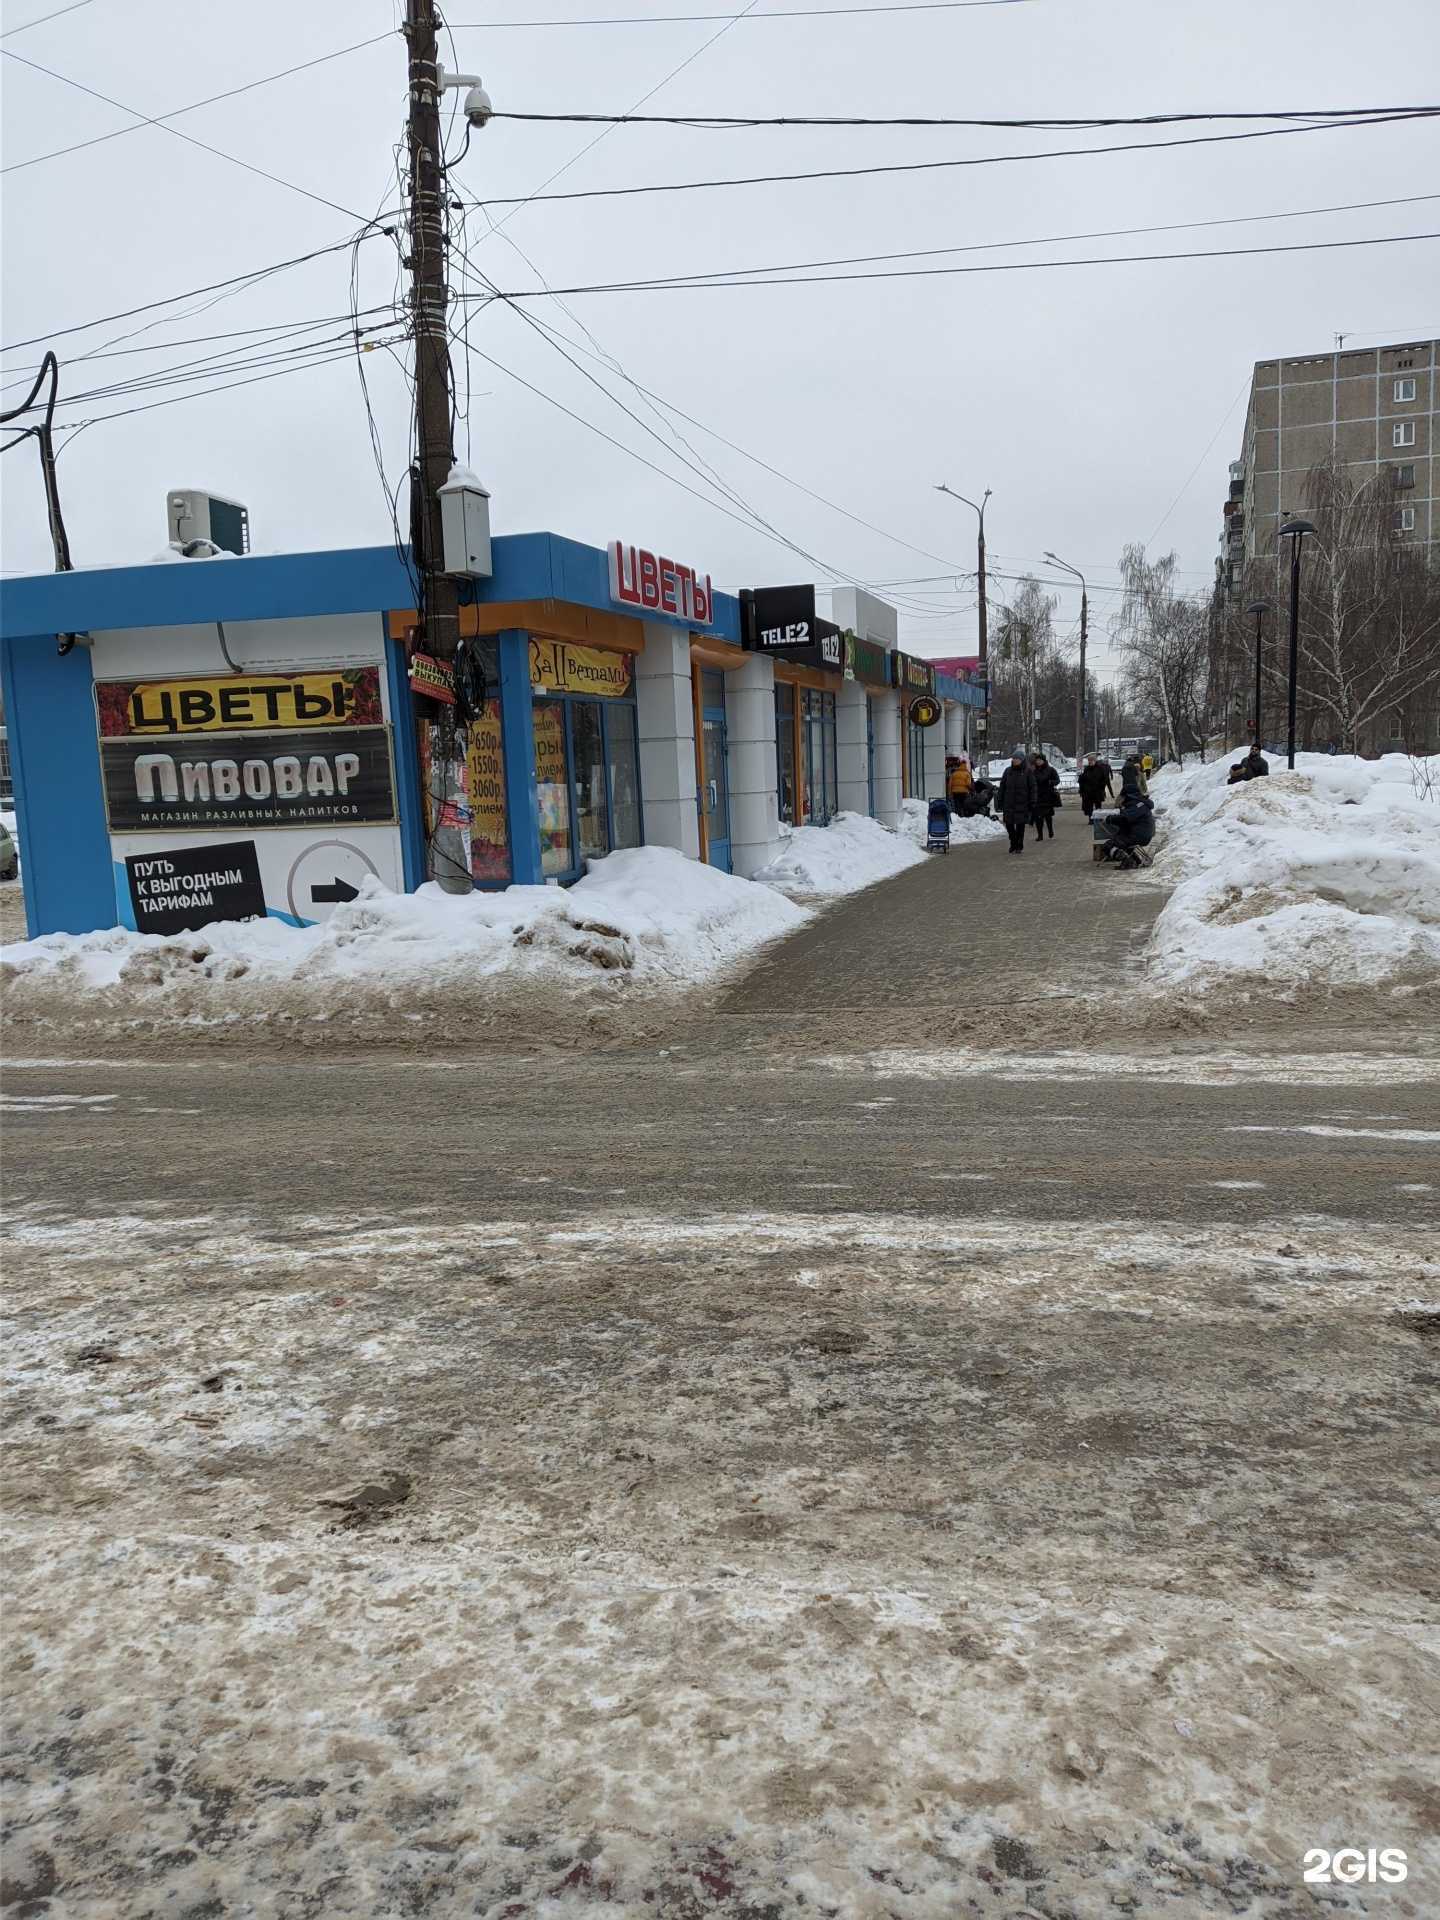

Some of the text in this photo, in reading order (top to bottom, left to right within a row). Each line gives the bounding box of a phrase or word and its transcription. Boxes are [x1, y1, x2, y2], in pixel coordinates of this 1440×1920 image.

[615, 539, 713, 624] ЦВЕТЫ
[760, 621, 810, 645] TELE2
[821, 633, 840, 664] TELE2
[131, 681, 347, 734] ЦВЕТЫ
[141, 804, 359, 822] МАГАЗИН РАЗЛИВНЫХ НАПИТКОВ
[133, 859, 175, 878] ПУТЬ
[136, 868, 243, 896] К ВЫГОДНЫМ
[139, 891, 214, 913] ТАРИФАМ
